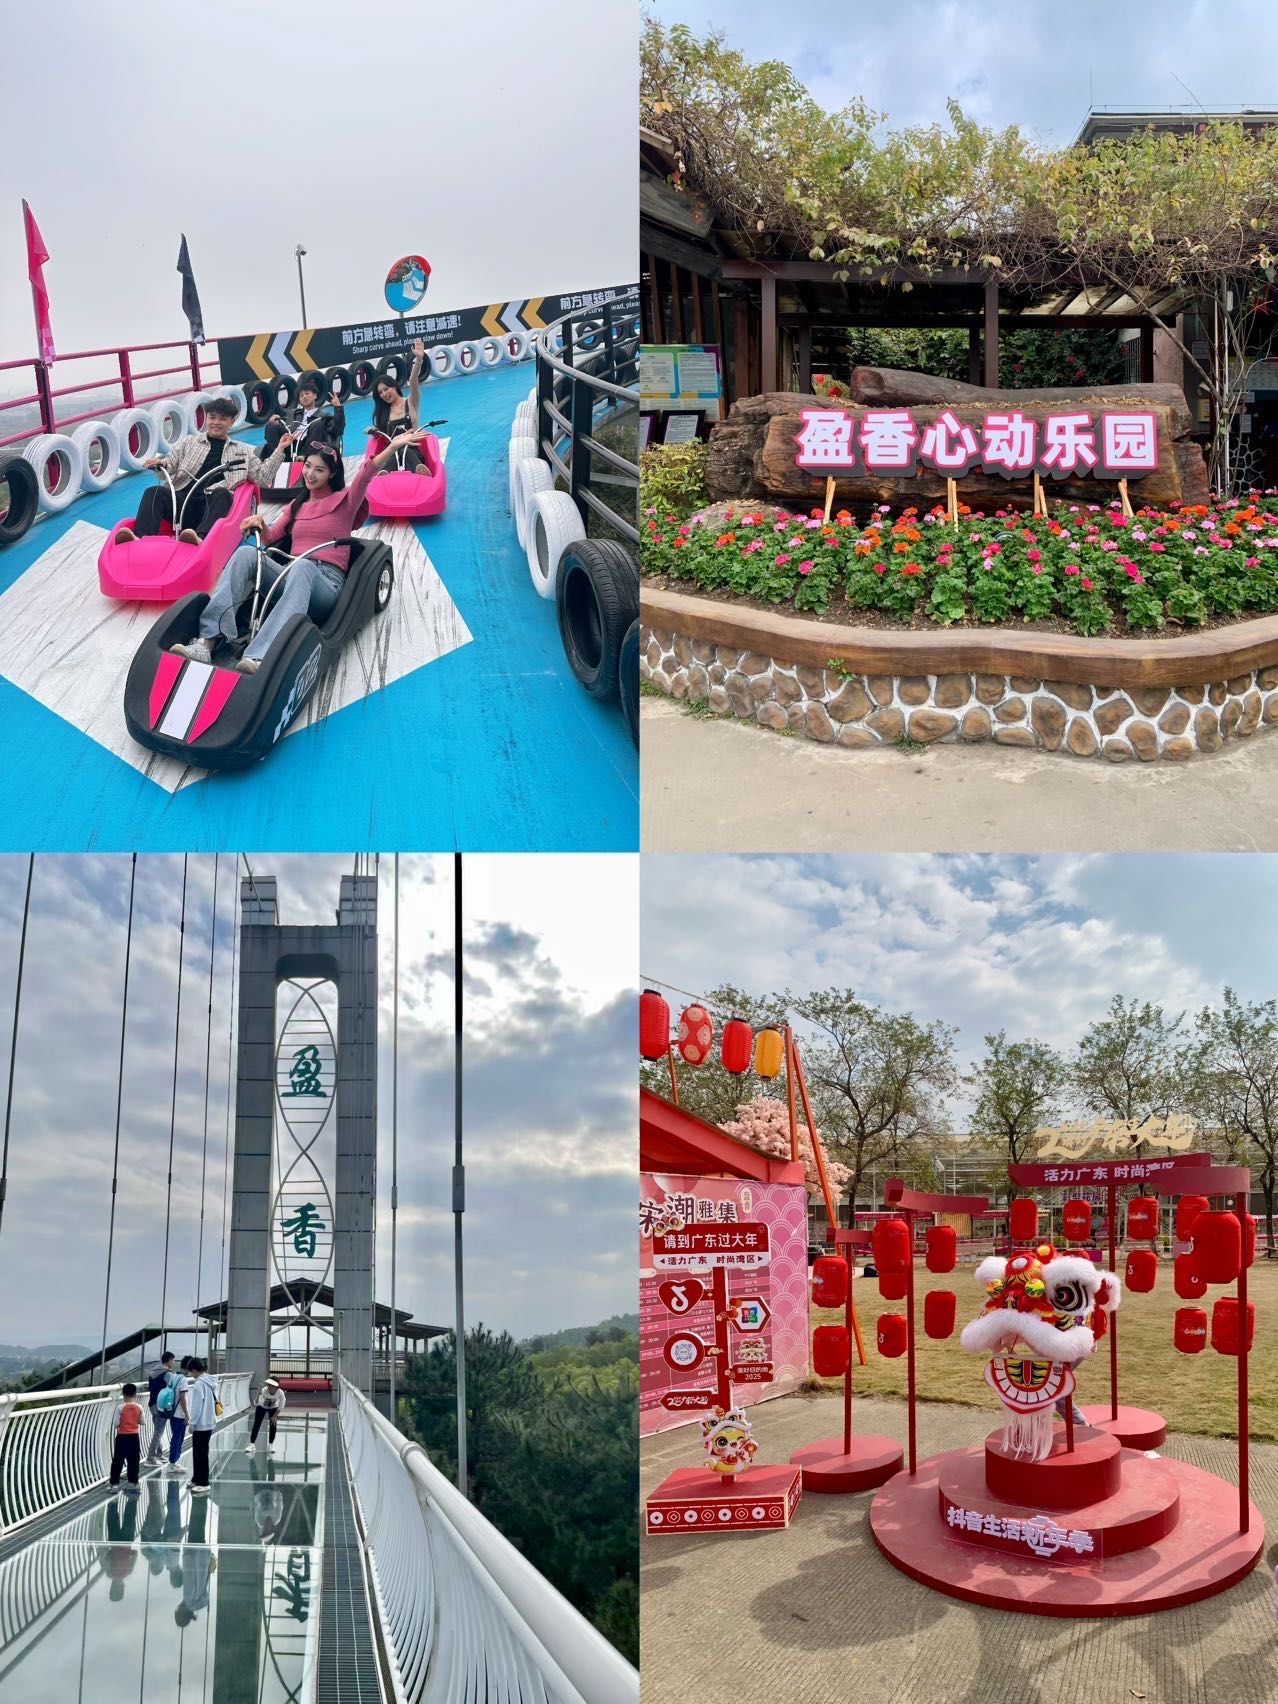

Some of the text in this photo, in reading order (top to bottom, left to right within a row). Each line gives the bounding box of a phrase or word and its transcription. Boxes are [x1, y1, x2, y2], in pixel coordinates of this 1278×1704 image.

[352, 345, 369, 354] Sharp
[369, 343, 384, 351] curve
[436, 331, 454, 340] down!
[797, 410, 1158, 470] 盈香心动乐园
[1044, 1166, 1109, 1182] 活力广东
[663, 1233, 759, 1249] 请到广东过大年
[668, 1254, 756, 1265] 活力广东 时尚湾区
